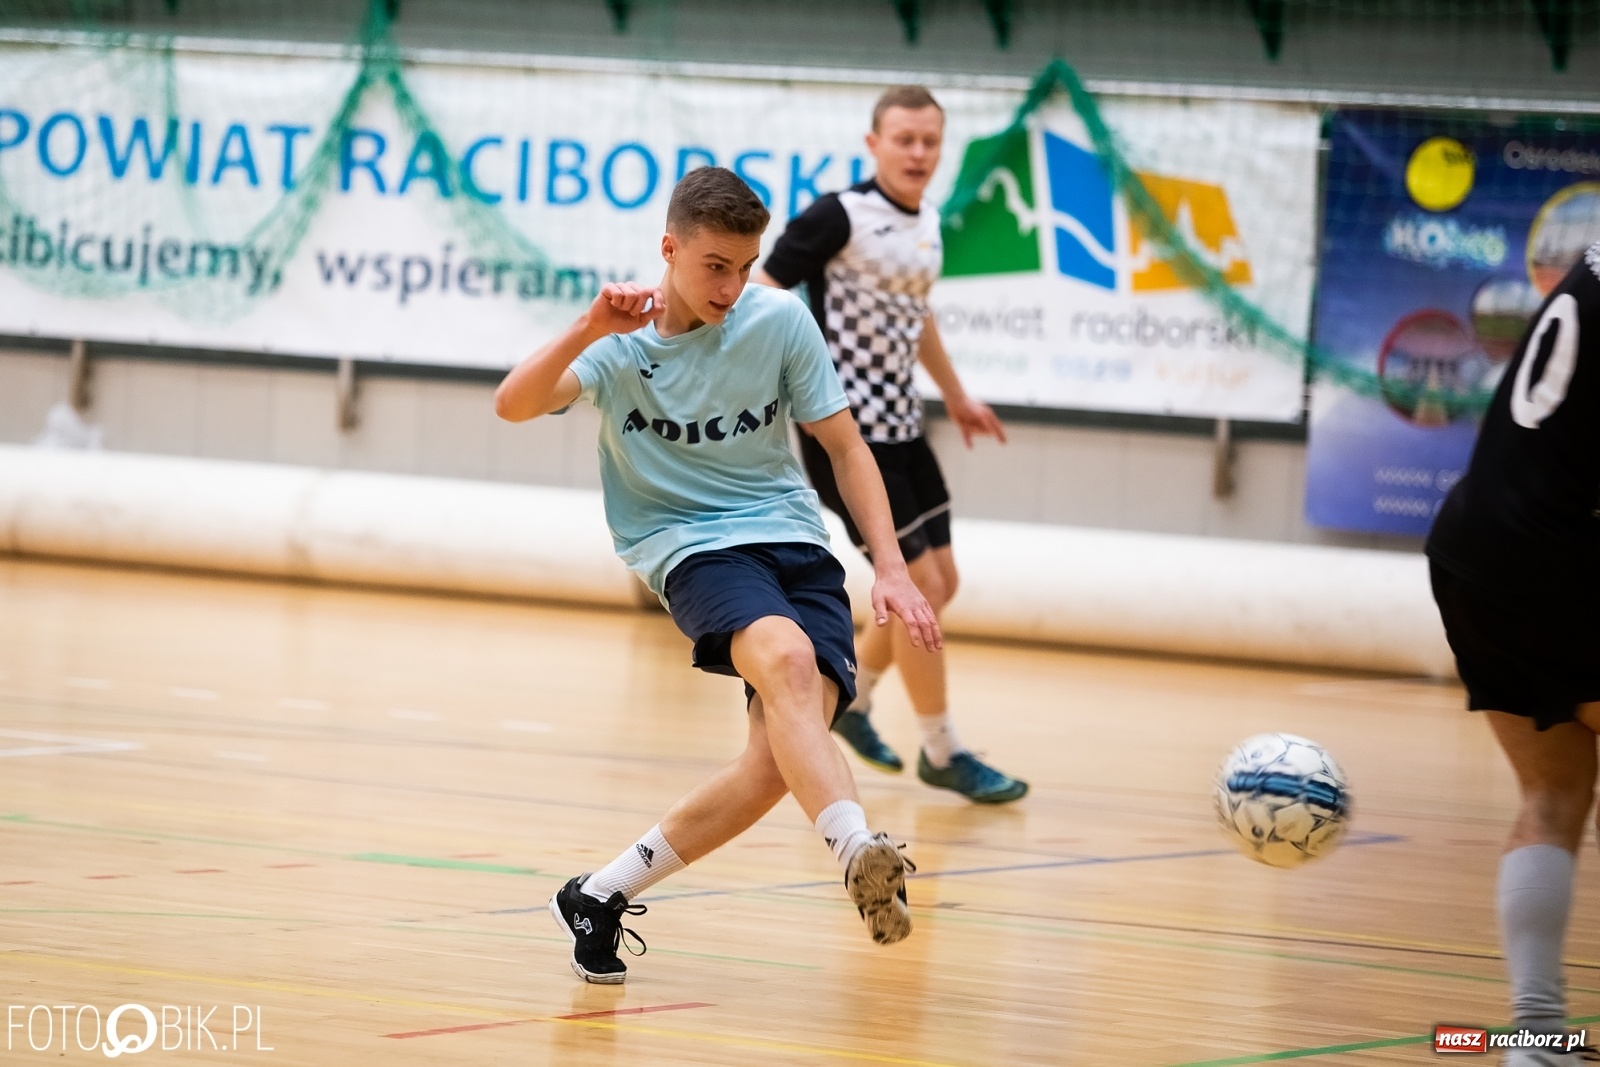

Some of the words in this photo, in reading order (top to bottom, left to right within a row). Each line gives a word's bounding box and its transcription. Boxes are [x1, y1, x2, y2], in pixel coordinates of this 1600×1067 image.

[0, 109, 311, 191] POWIAT
[0, 213, 282, 298] ibicujemy,
[935, 303, 1045, 340] owiat
